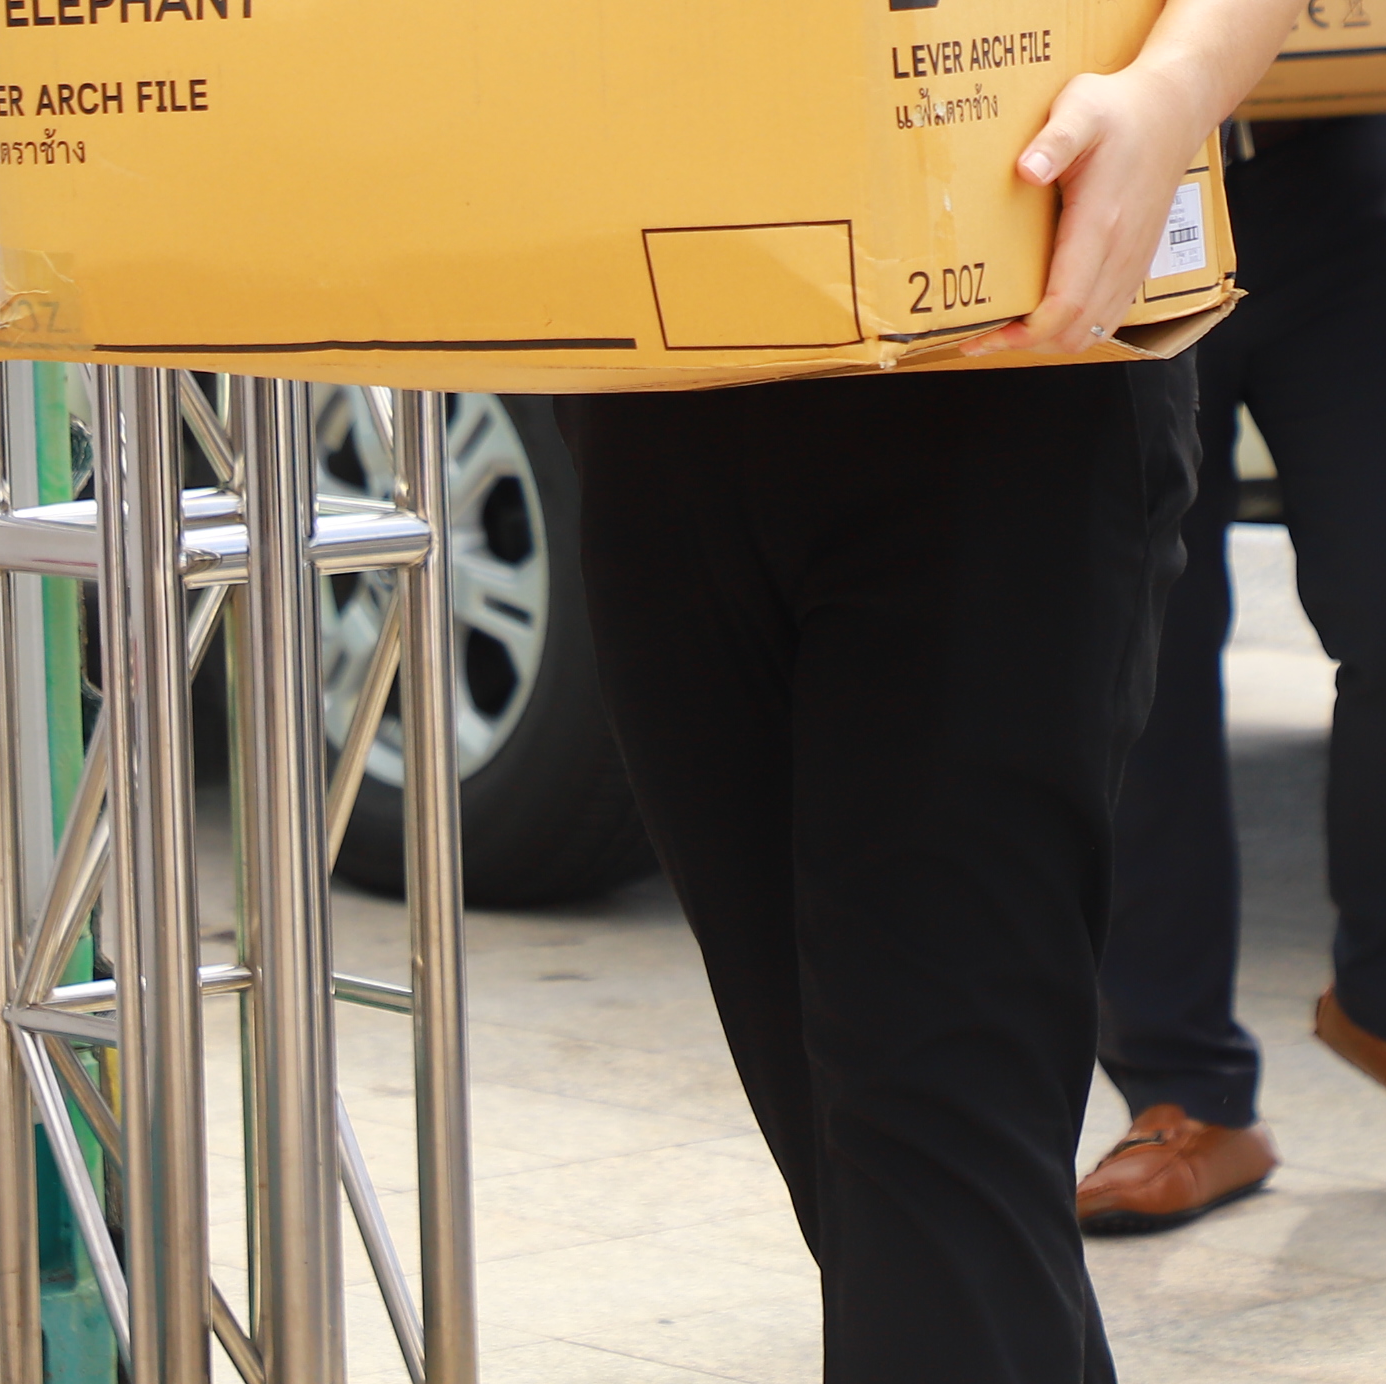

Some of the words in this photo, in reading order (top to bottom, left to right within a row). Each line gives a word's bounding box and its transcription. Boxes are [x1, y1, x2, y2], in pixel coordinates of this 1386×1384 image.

[892, 41, 964, 79] LEVER
[970, 34, 1015, 71] ARCH
[1020, 30, 1051, 64] FILE
[36, 81, 124, 116] ARCH
[137, 78, 209, 113] FILE
[909, 272, 934, 314] 2
